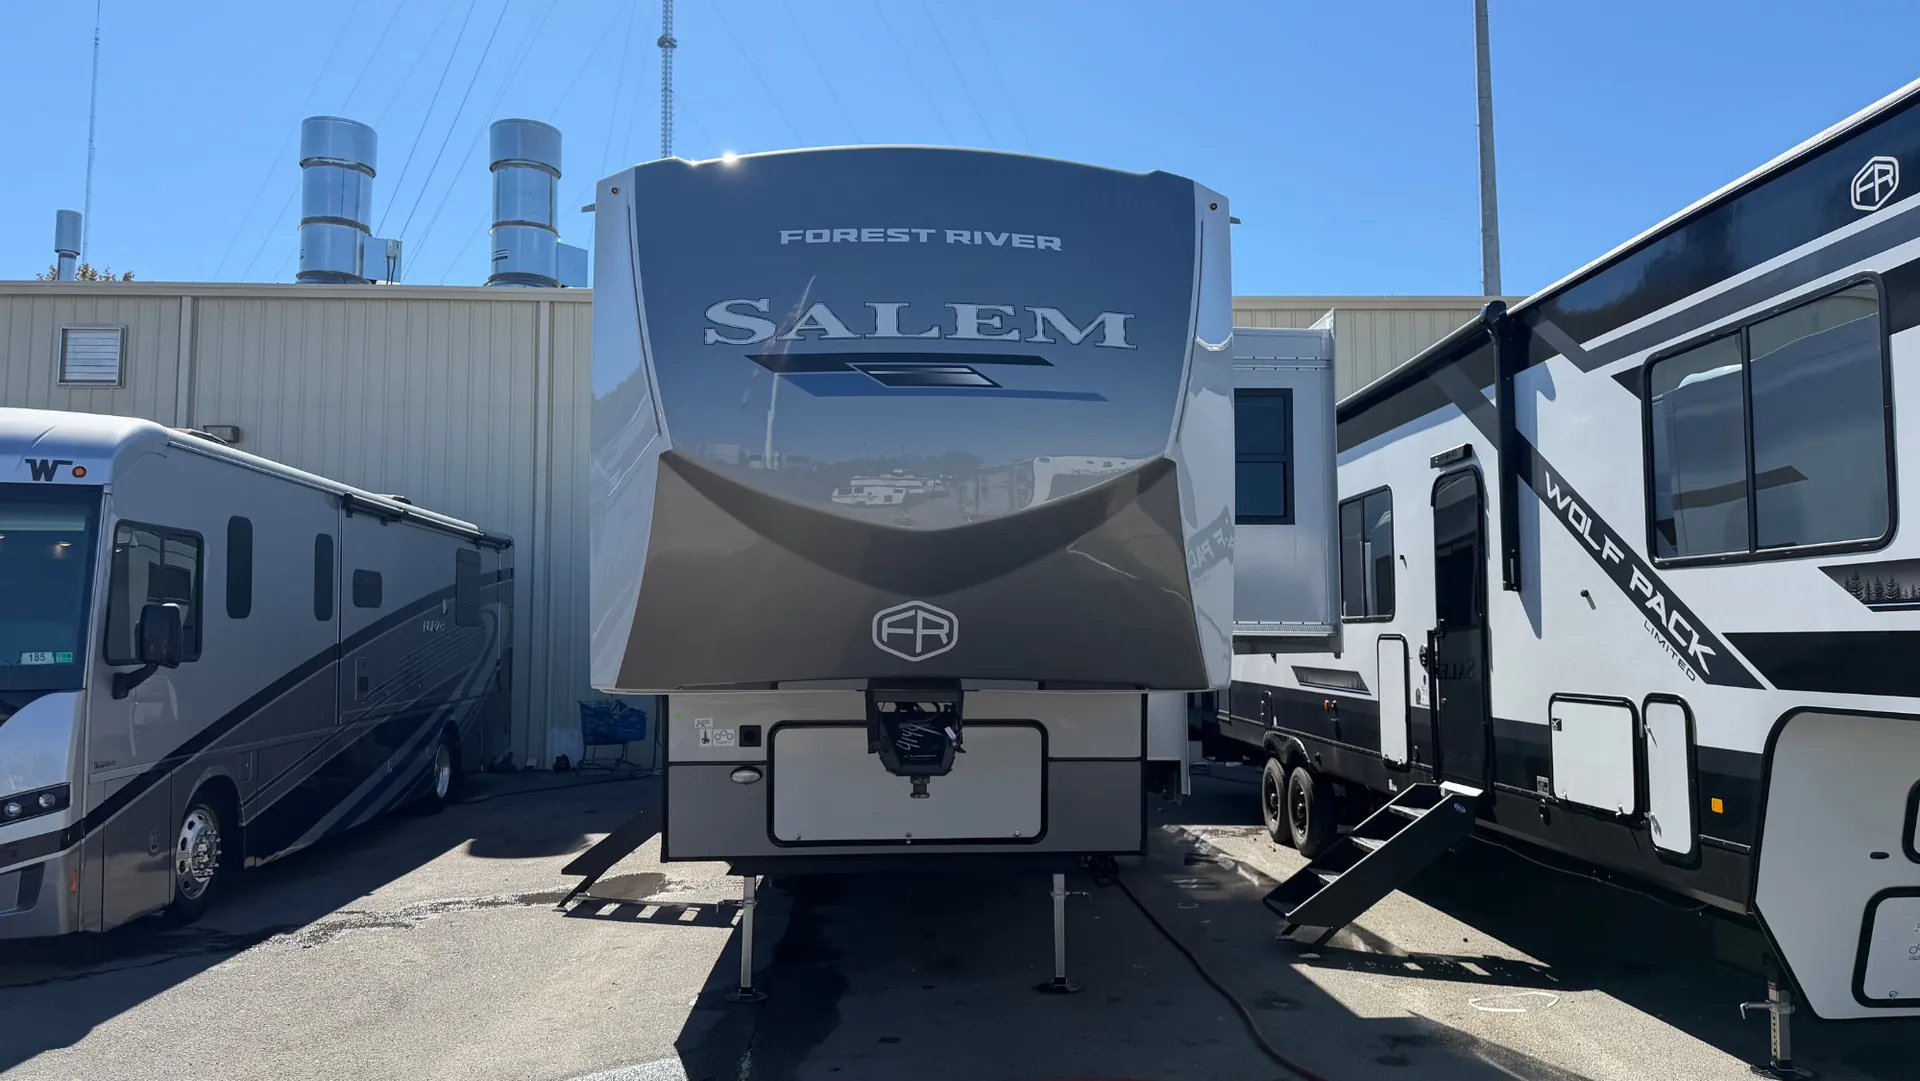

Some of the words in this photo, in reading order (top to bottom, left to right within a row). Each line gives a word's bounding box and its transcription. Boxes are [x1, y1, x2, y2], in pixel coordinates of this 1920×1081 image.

[779, 228, 936, 245] FOREST
[944, 229, 1062, 251] RIVER
[703, 297, 1138, 350] SALEM
[1545, 471, 1625, 564] WOLF
[1629, 564, 1717, 676] PACK
[28, 653, 46, 662] 185
[1643, 620, 1697, 682] LIMITED
